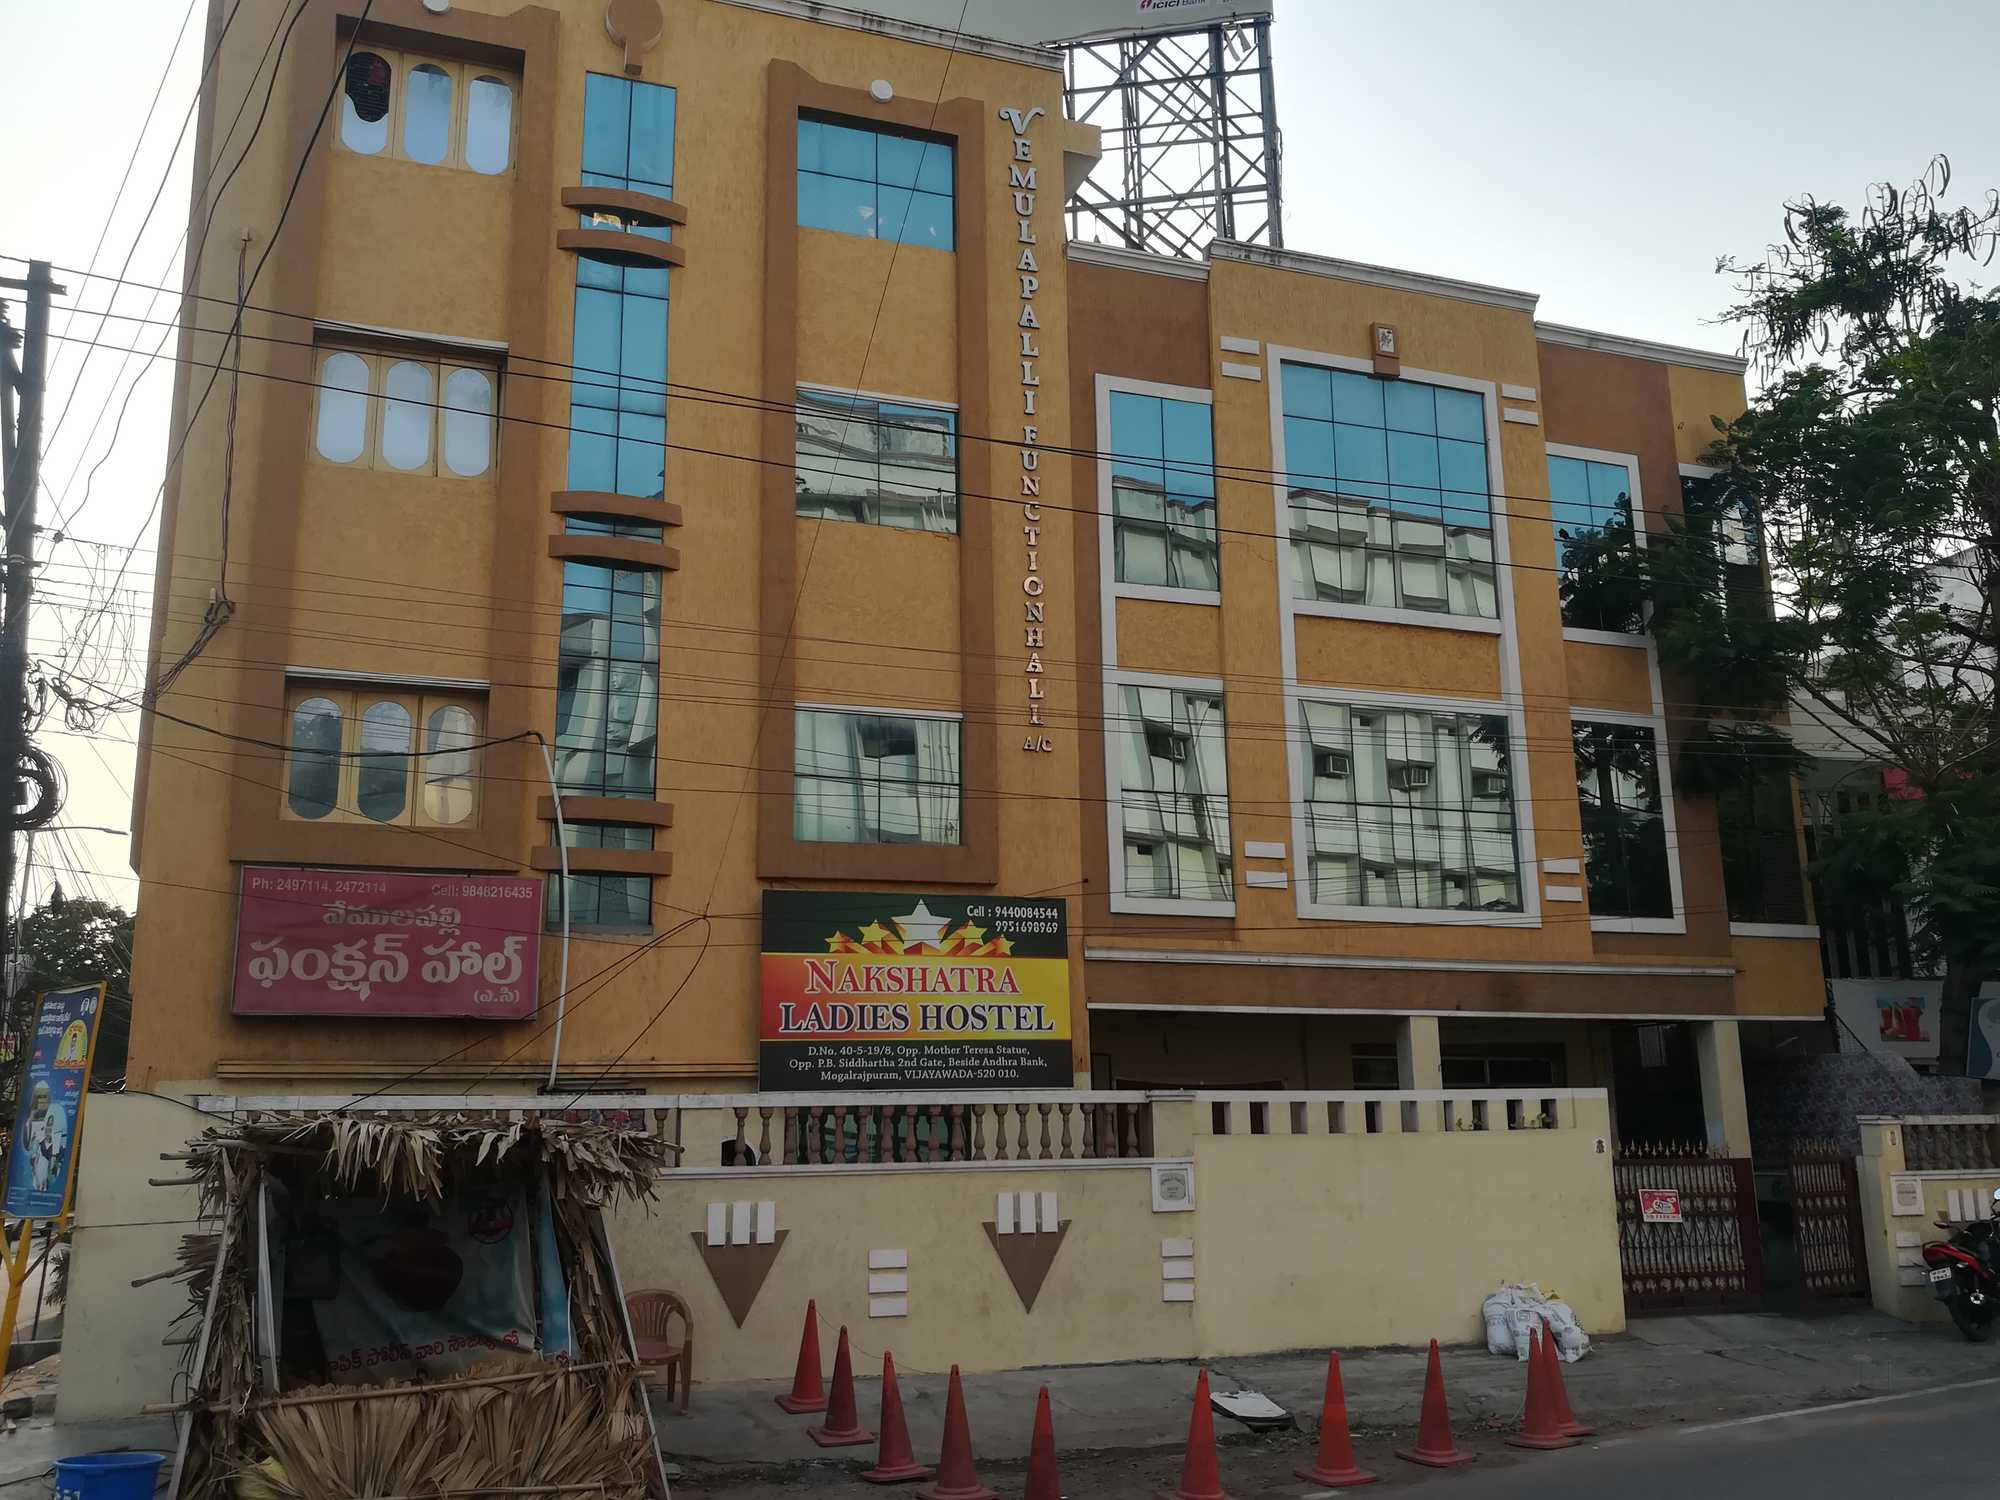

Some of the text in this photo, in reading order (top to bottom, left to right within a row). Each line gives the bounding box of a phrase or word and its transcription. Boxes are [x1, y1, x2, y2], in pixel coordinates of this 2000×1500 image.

[999, 106, 1046, 726] VEMULAPALLI FUNCTION HALL
[1022, 735, 1053, 752] A/C
[252, 877, 273, 889] Ph:
[335, 880, 386, 893] 2472114
[431, 883, 459, 897] Cell:
[966, 905, 985, 917] Cell
[994, 906, 1059, 919] 9440084544
[995, 920, 1059, 934] 9951698969
[421, 935, 528, 985] హాల్
[779, 1002, 1055, 1033] LADIES HOSTEL
[808, 1044, 1030, 1057] D.No. 40-5-19/8, Opp. Mother Teresa Statue,
[789, 1056, 1048, 1071] Opp. P.B. Siddhartha 2nd Gate, Beside Andhra Bank,
[820, 1068, 1020, 1083] Mogalrajpuram, VIJAYAWADA-520 010.
